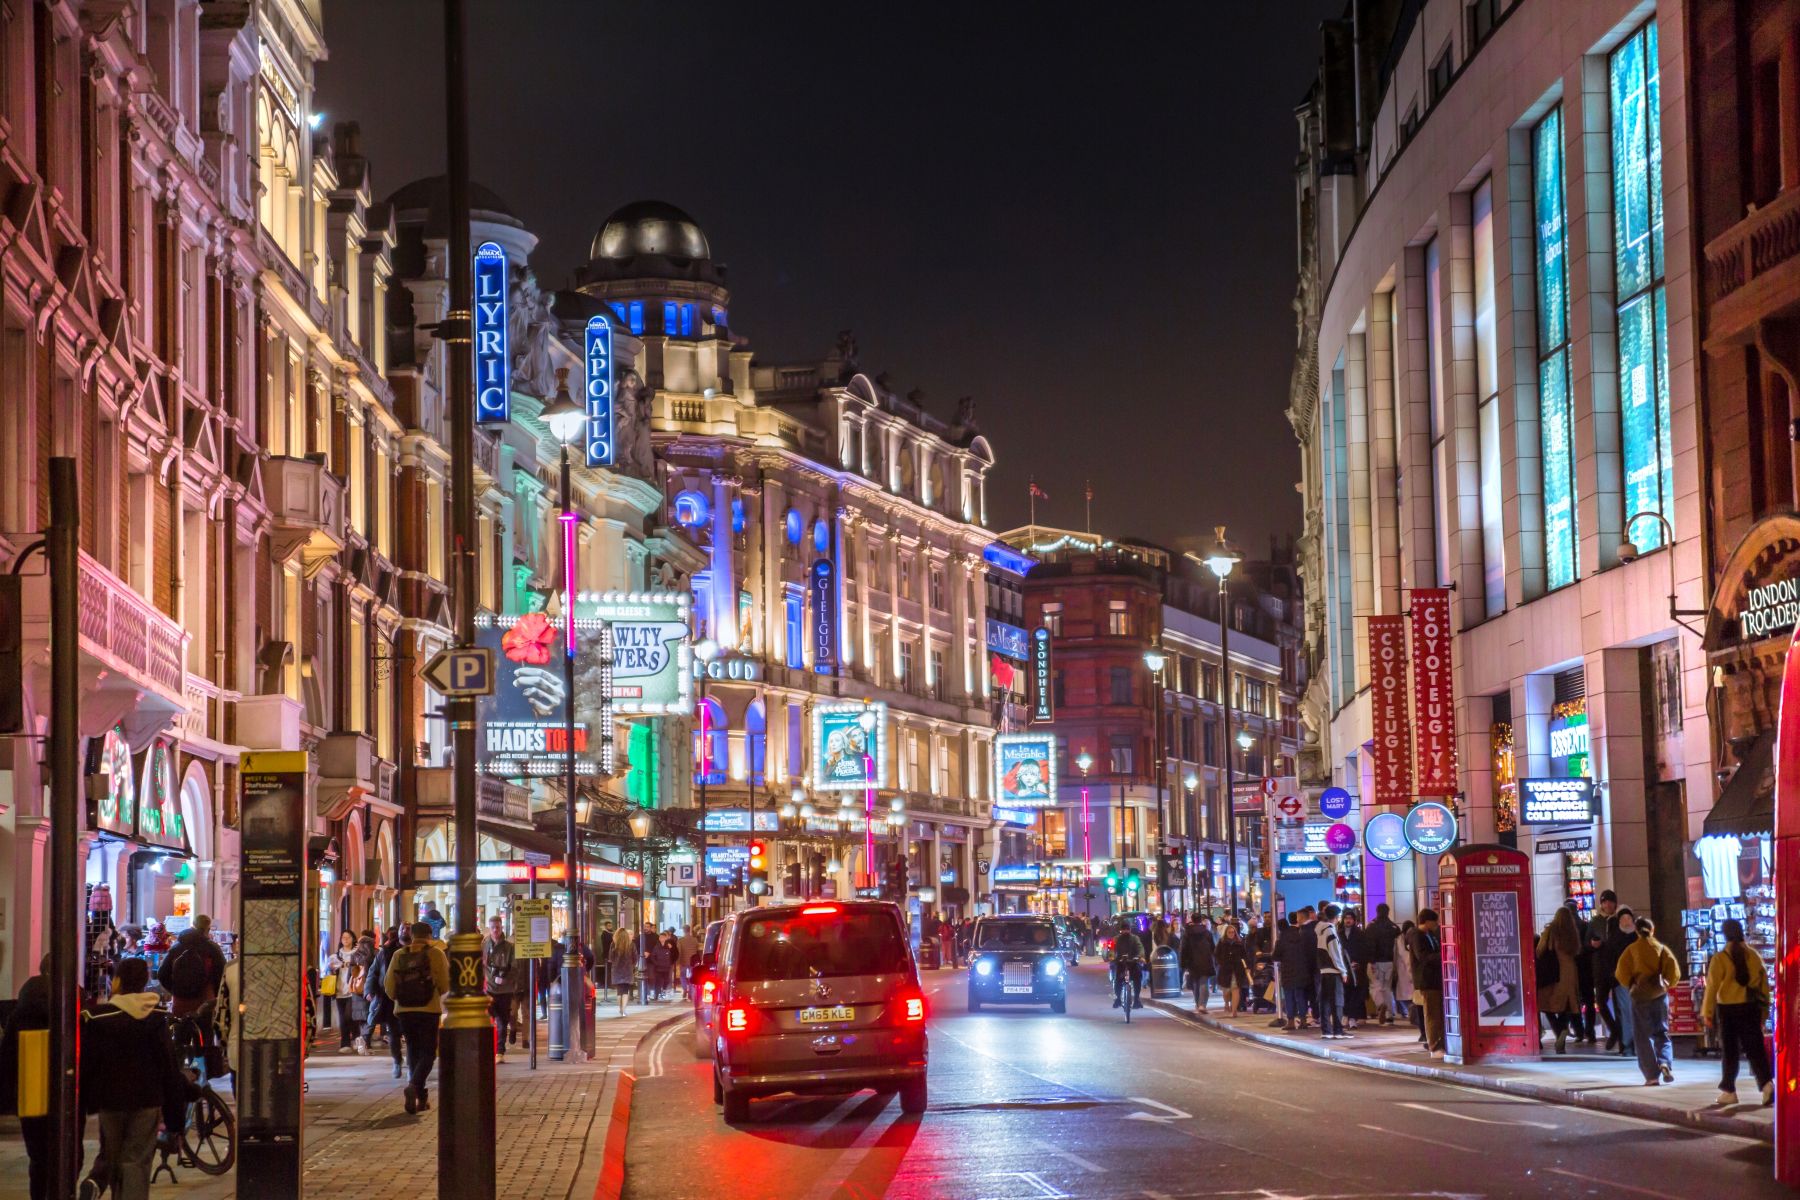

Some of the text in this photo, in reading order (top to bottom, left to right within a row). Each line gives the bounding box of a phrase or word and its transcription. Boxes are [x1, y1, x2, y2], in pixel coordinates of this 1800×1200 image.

[479, 274, 504, 411] LYRIC
[589, 338, 609, 459] APOLLO
[1748, 578, 1797, 611] LONDON
[818, 578, 830, 658] GIELGUD
[457, 657, 479, 687] P
[1037, 641, 1048, 715] SONDHEIM
[1527, 782, 1585, 792] TOBACCO
[1535, 792, 1579, 801] VAPES
[1527, 801, 1587, 811] SANDWICH
[1526, 811, 1551, 820] COLD
[1412, 839, 1428, 852] OPEN
[1373, 847, 1388, 858] OPEN
[682, 866, 692, 879] P
[1467, 865, 1520, 873] TELEPHONE
[1482, 893, 1507, 901] LADY
[1482, 902, 1509, 910] GAGA
[1488, 938, 1506, 946] OUT
[1486, 946, 1509, 954] NOW
[831, 1009, 852, 1019] KLE
